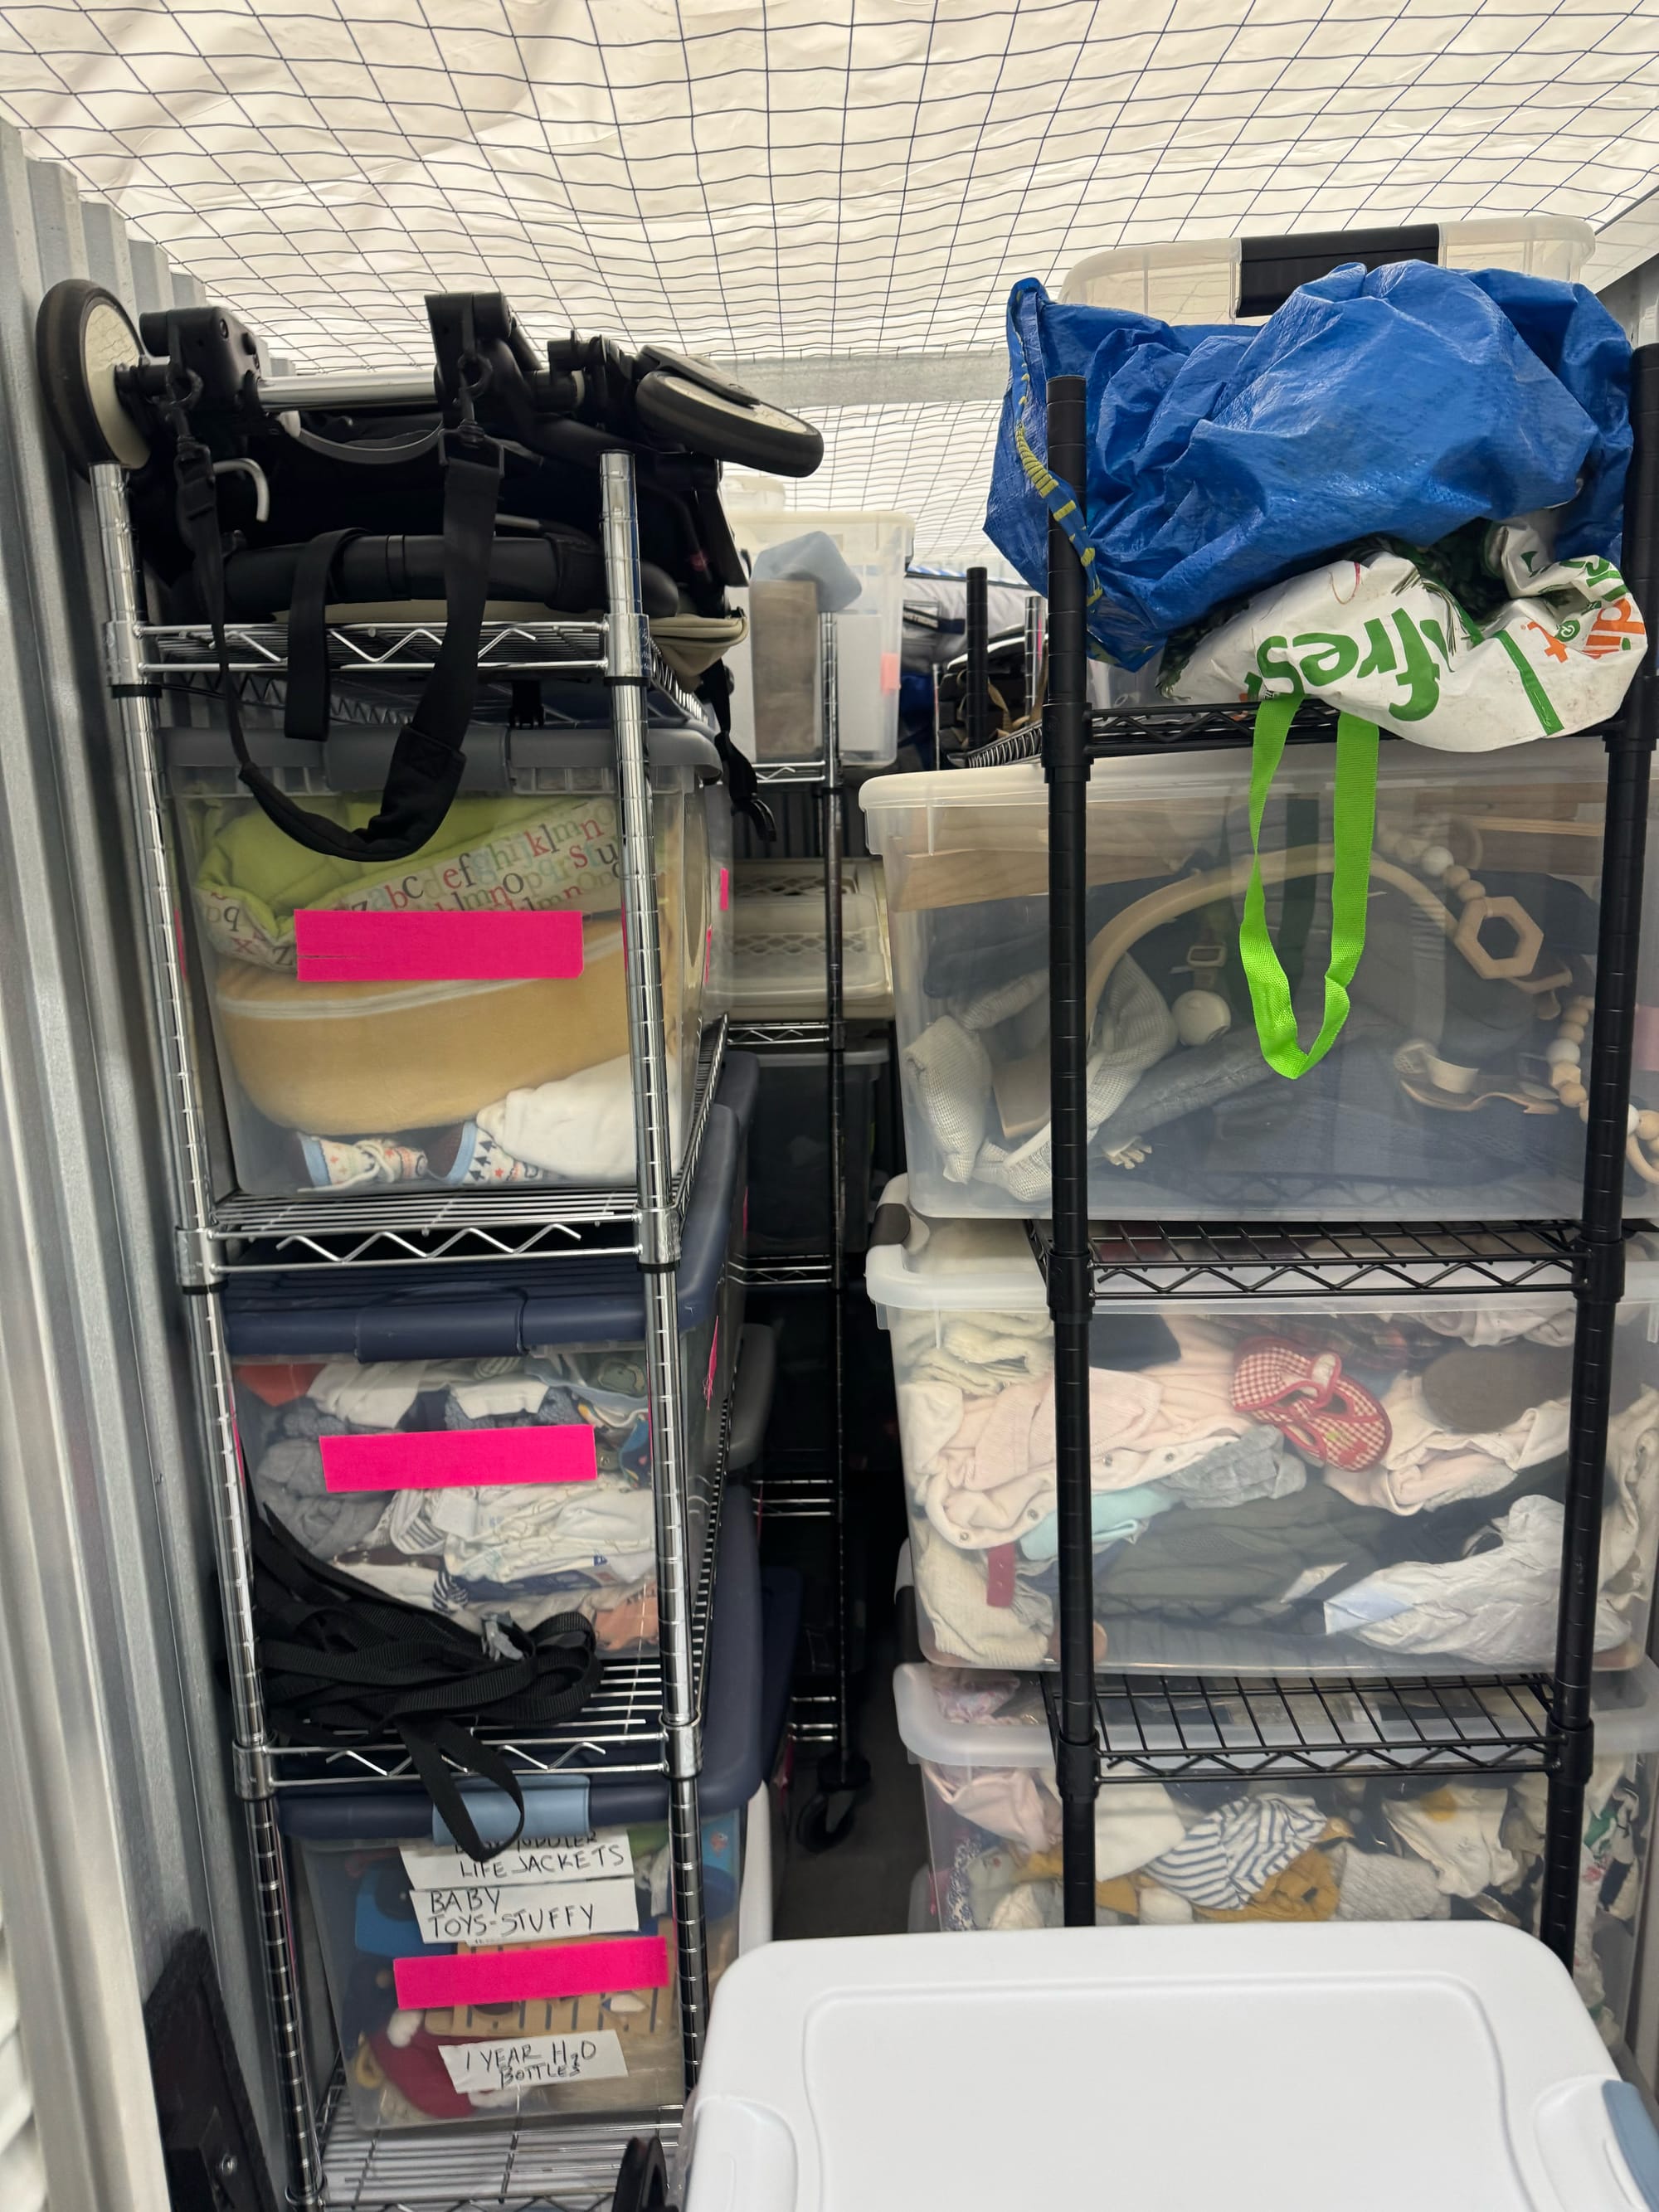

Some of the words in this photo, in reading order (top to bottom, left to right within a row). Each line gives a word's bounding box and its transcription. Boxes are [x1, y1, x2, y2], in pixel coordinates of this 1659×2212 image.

[1244, 607, 1440, 722] fres
[460, 1860, 507, 1878] LIFE
[511, 1845, 624, 1874] JACKETS
[430, 1887, 500, 1915] BABY
[428, 1903, 594, 1938] TOYS-STUFFY
[479, 2044, 542, 2073] YEAR
[498, 2062, 581, 2090] BOTTLES
